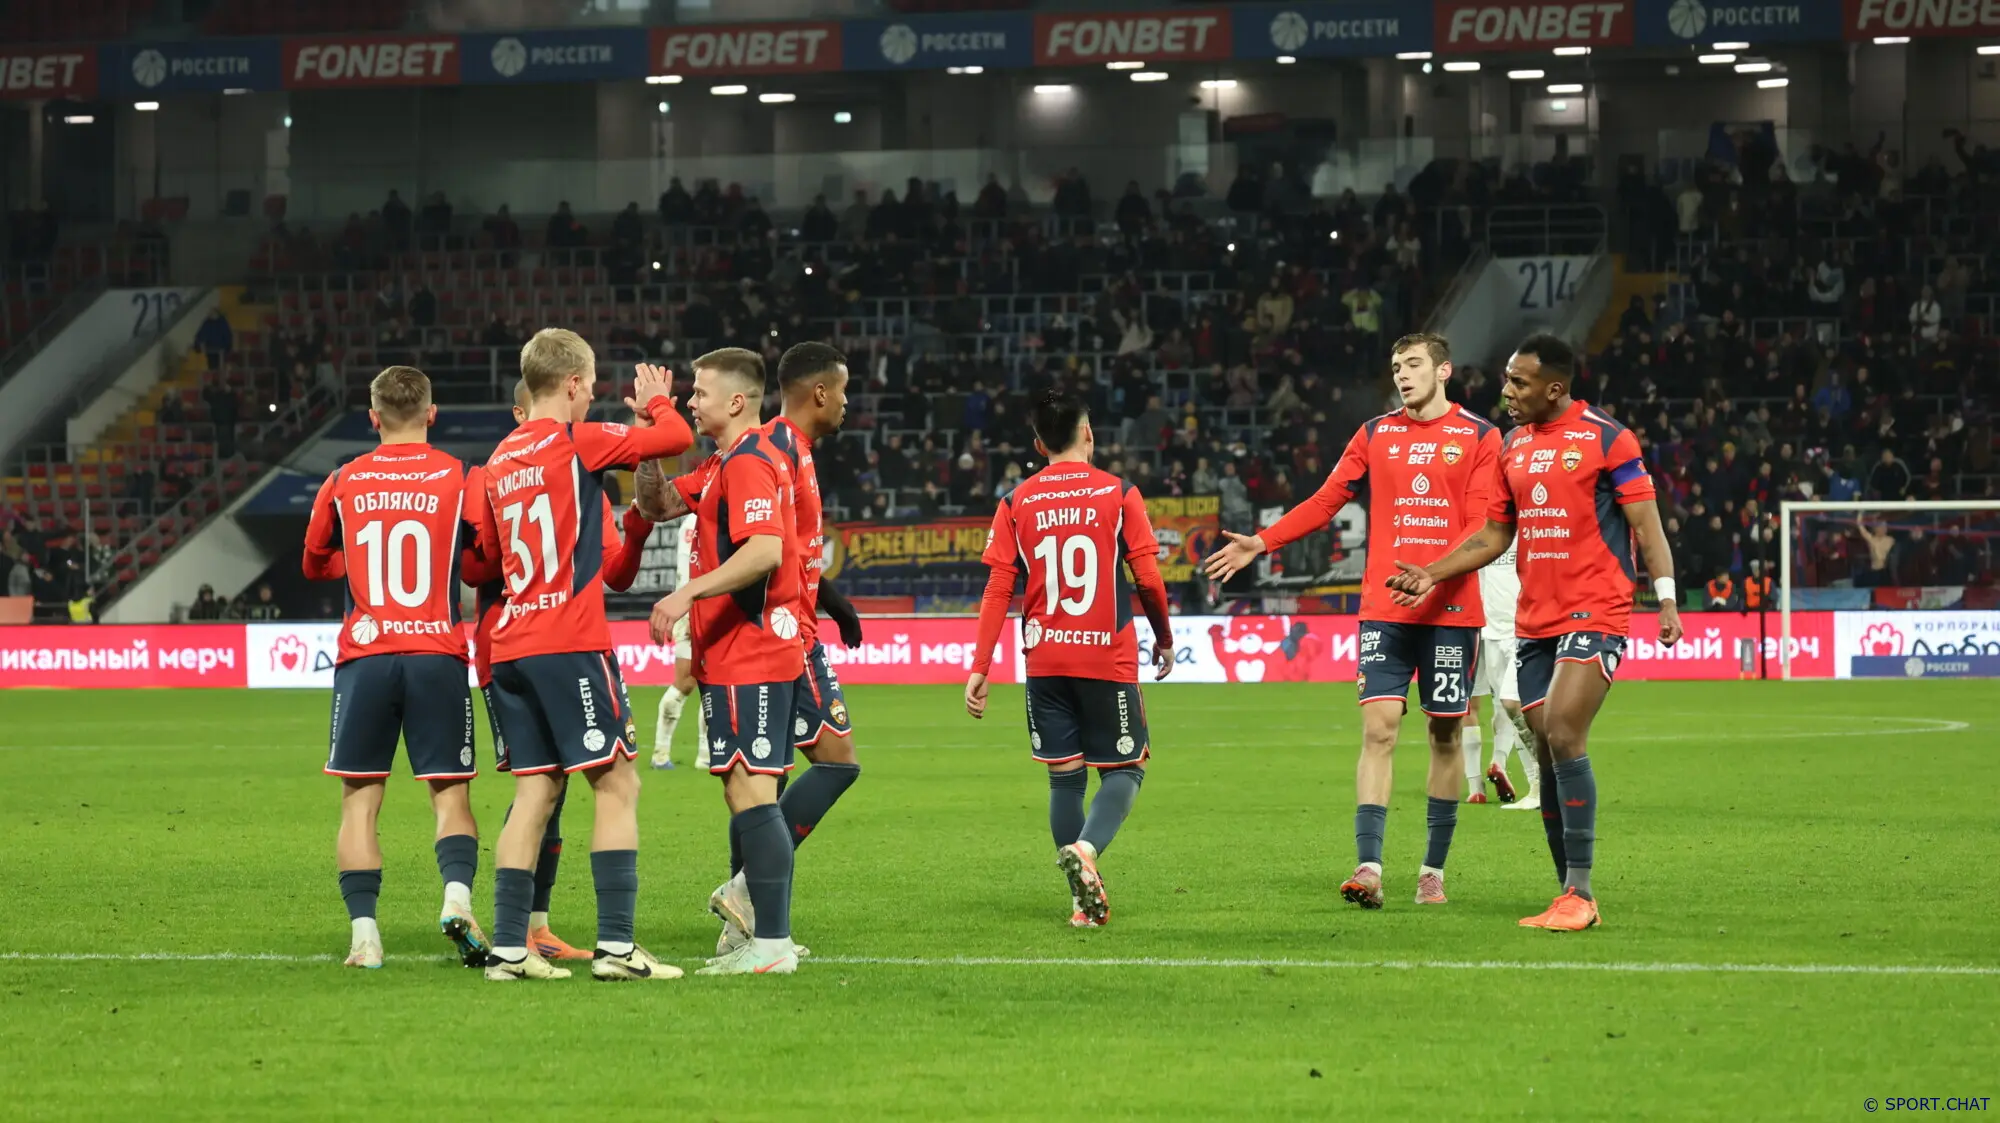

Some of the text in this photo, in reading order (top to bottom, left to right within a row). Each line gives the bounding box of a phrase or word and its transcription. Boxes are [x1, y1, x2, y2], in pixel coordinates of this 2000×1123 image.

[1449, 3, 1624, 44] FONBET
[1712, 4, 1800, 27] РОССЕТИ
[1045, 17, 1218, 58] FONBET
[1312, 18, 1399, 40] РОССЕТИ
[663, 29, 828, 69] FONBET
[921, 32, 1006, 52] РОССЕТИ
[171, 56, 250, 76] РОССЕТИ
[294, 42, 456, 80] FONBET
[531, 44, 613, 66] РОССЕТИ
[1519, 260, 1577, 309] 214
[1408, 442, 1438, 453] FON
[1531, 449, 1557, 462] FON
[1407, 454, 1436, 465] BET
[1528, 461, 1554, 474] BET
[347, 471, 428, 482] АЭРОФЛОТ
[496, 465, 545, 500] КИСЛЯК
[353, 491, 440, 514] ОБЛЯКОВ
[744, 498, 772, 512] FON
[1022, 487, 1095, 506] АЭРОФЛОТ
[745, 510, 773, 524] BET
[1035, 507, 1100, 531] ДАНИ Р.
[1402, 514, 1448, 528] билайн
[503, 493, 559, 595] 31
[355, 519, 432, 608] 10
[1033, 534, 1098, 616] 19
[382, 619, 452, 635] РОССЕТИ
[1044, 628, 1112, 646] РОССЕТИ
[1360, 631, 1382, 643] FON
[0, 636, 235, 674] икальный мерч
[1361, 640, 1381, 653] BET
[1432, 672, 1462, 704] 23
[578, 677, 597, 728] РОССЕТИ
[757, 685, 769, 735] РОССЕТИ
[1117, 690, 1129, 735] РОССЕТИ
[464, 697, 472, 744] РОССЕТИ
